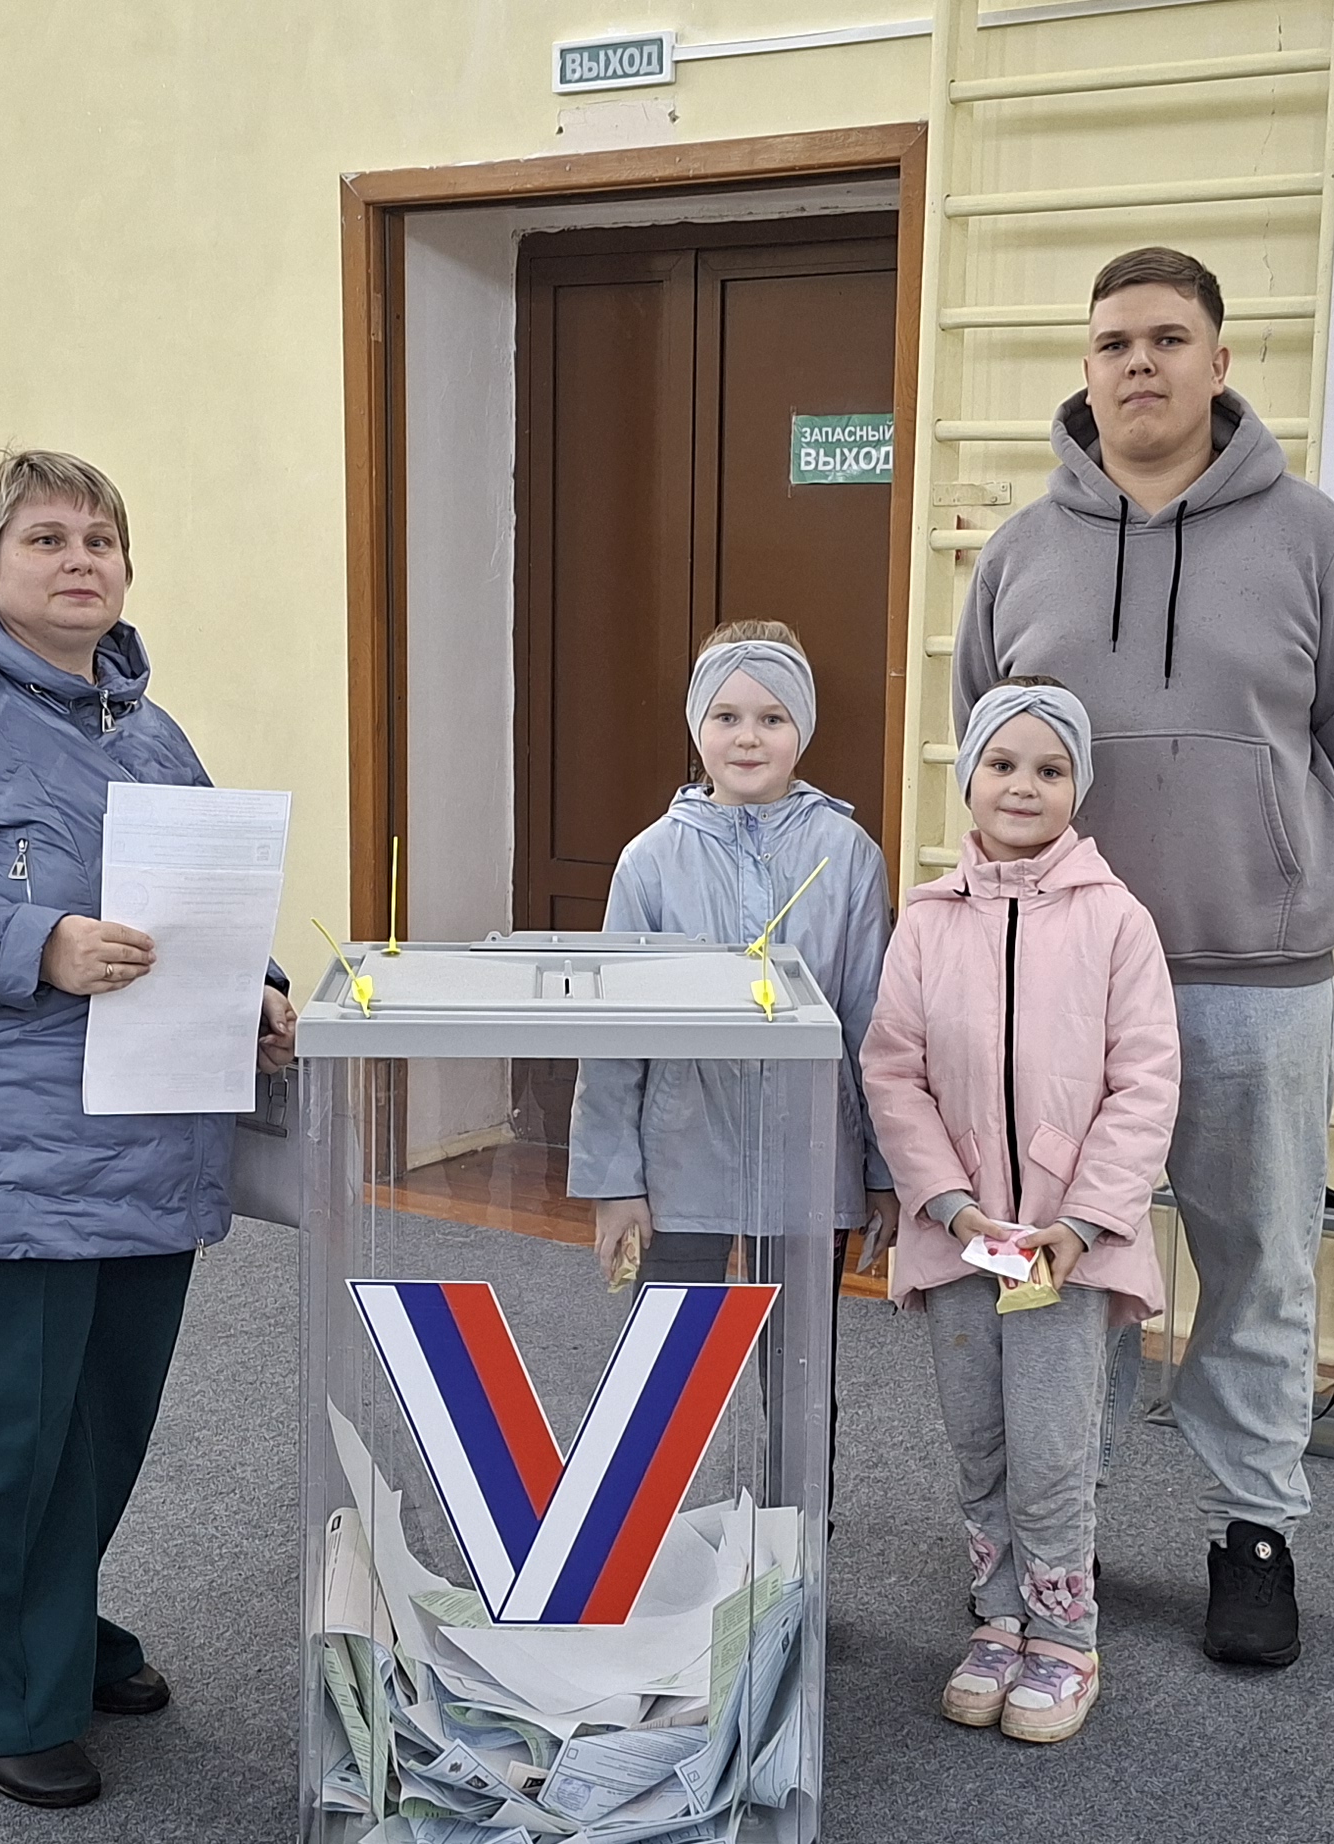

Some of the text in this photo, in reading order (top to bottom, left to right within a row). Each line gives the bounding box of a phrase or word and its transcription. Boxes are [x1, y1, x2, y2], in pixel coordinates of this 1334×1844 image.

[566, 45, 660, 82] ВЫХОД
[800, 421, 894, 442] ЗАПАСНЫЙ
[800, 445, 893, 474] ВЫХОД
